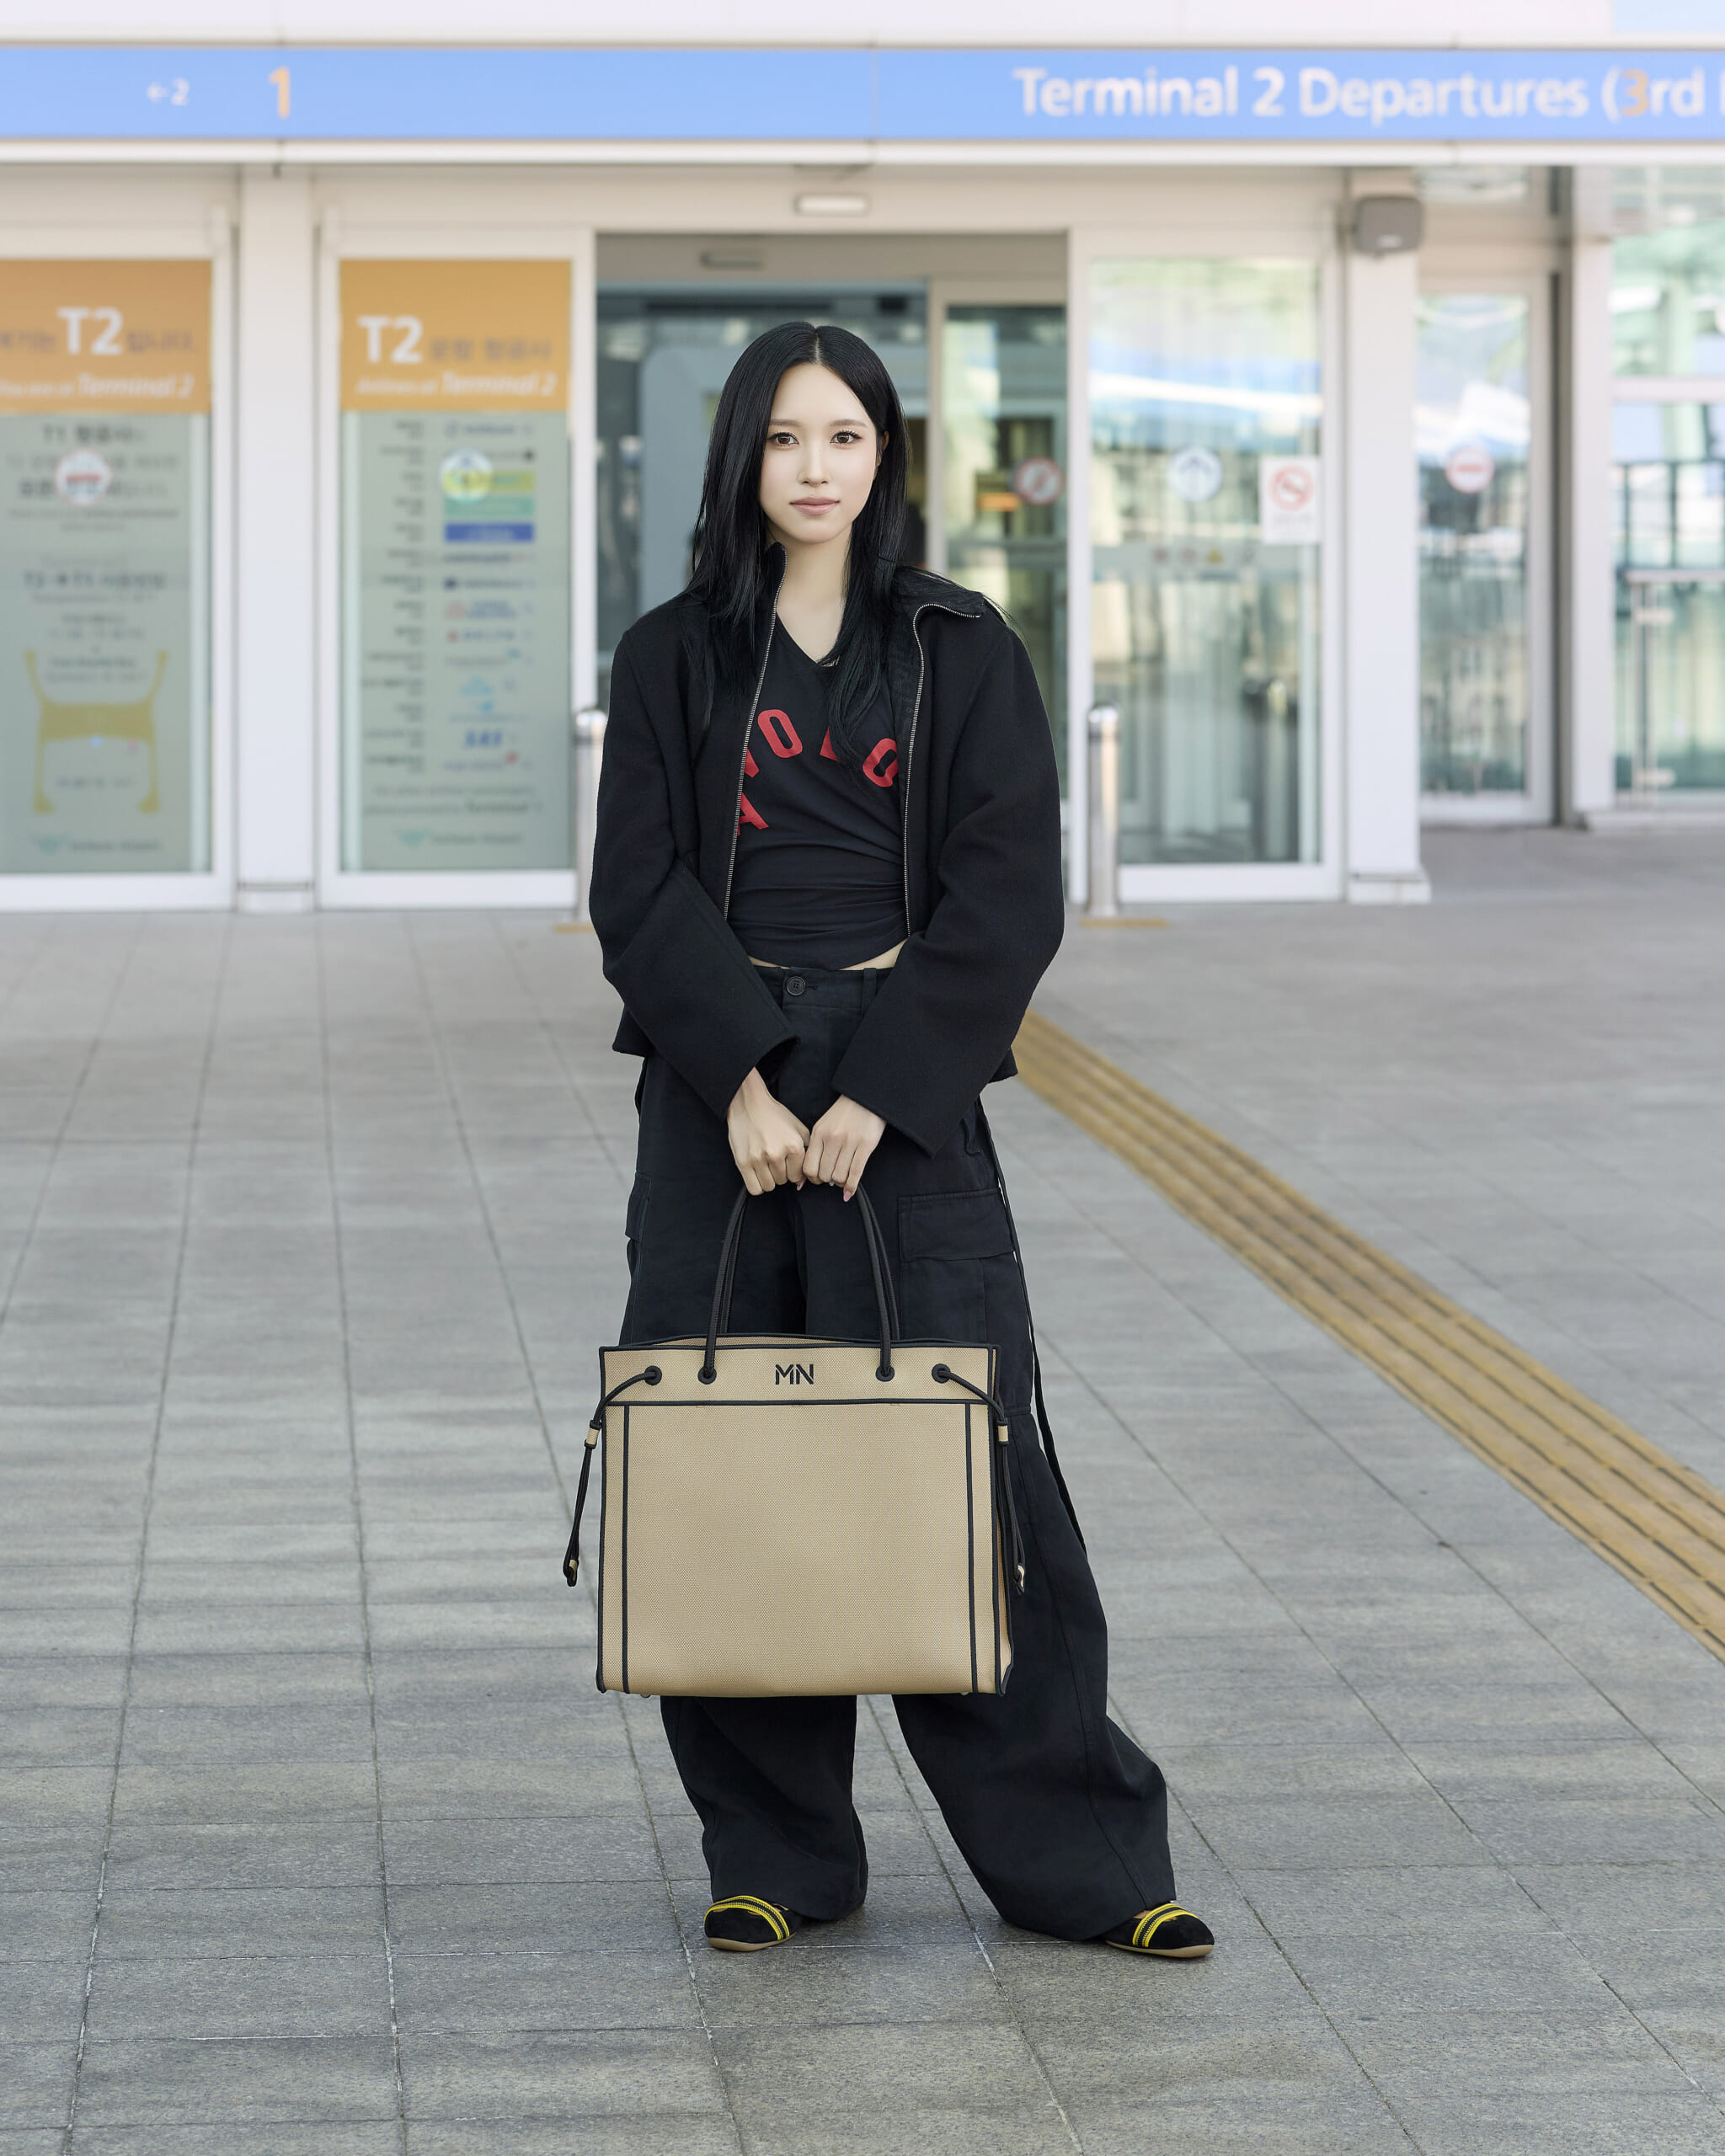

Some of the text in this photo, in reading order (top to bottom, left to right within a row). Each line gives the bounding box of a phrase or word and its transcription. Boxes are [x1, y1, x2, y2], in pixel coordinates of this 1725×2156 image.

[171, 77, 190, 106] 2
[268, 66, 291, 120] 1
[1012, 65, 1239, 117] Terminal
[1252, 66, 1286, 117] 2
[1298, 67, 1590, 129] Departures
[1601, 65, 1706, 125] (3rd
[56, 307, 124, 356] T2
[356, 315, 424, 364] T2
[76, 373, 175, 398] Terminal
[176, 373, 195, 399] 2
[441, 370, 540, 398] Terminal
[541, 370, 558, 398] 2
[775, 1364, 814, 1385] MN
